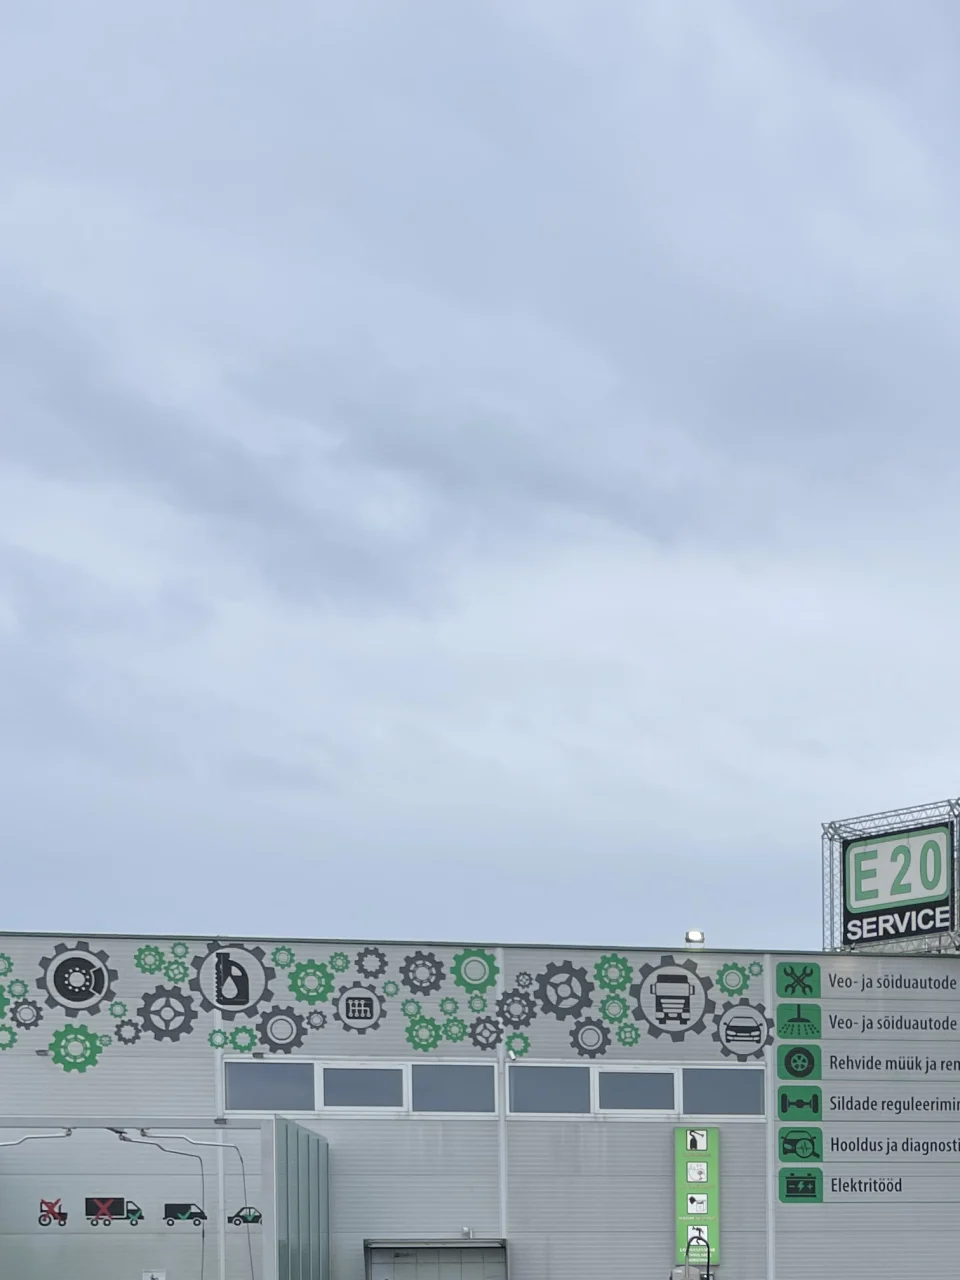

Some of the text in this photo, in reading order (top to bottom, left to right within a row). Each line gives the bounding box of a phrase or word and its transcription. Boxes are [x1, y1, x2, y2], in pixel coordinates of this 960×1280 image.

[854, 840, 942, 901] E 20
[846, 906, 950, 941] SERVICE
[829, 973, 858, 989] Veo-
[861, 975, 873, 992] ja
[876, 974, 957, 990] sõiduautode
[829, 1014, 859, 1030] Veo-
[861, 1015, 874, 1033] ja
[877, 1015, 957, 1031] sõiduautode
[830, 1055, 882, 1070] Rehvide
[885, 1056, 922, 1071] müük
[925, 1057, 937, 1074] ja
[830, 1096, 878, 1111] Sildade
[831, 1137, 883, 1152] Hooldus
[885, 1138, 898, 1155] ja
[831, 1178, 902, 1193] Elektritööd
